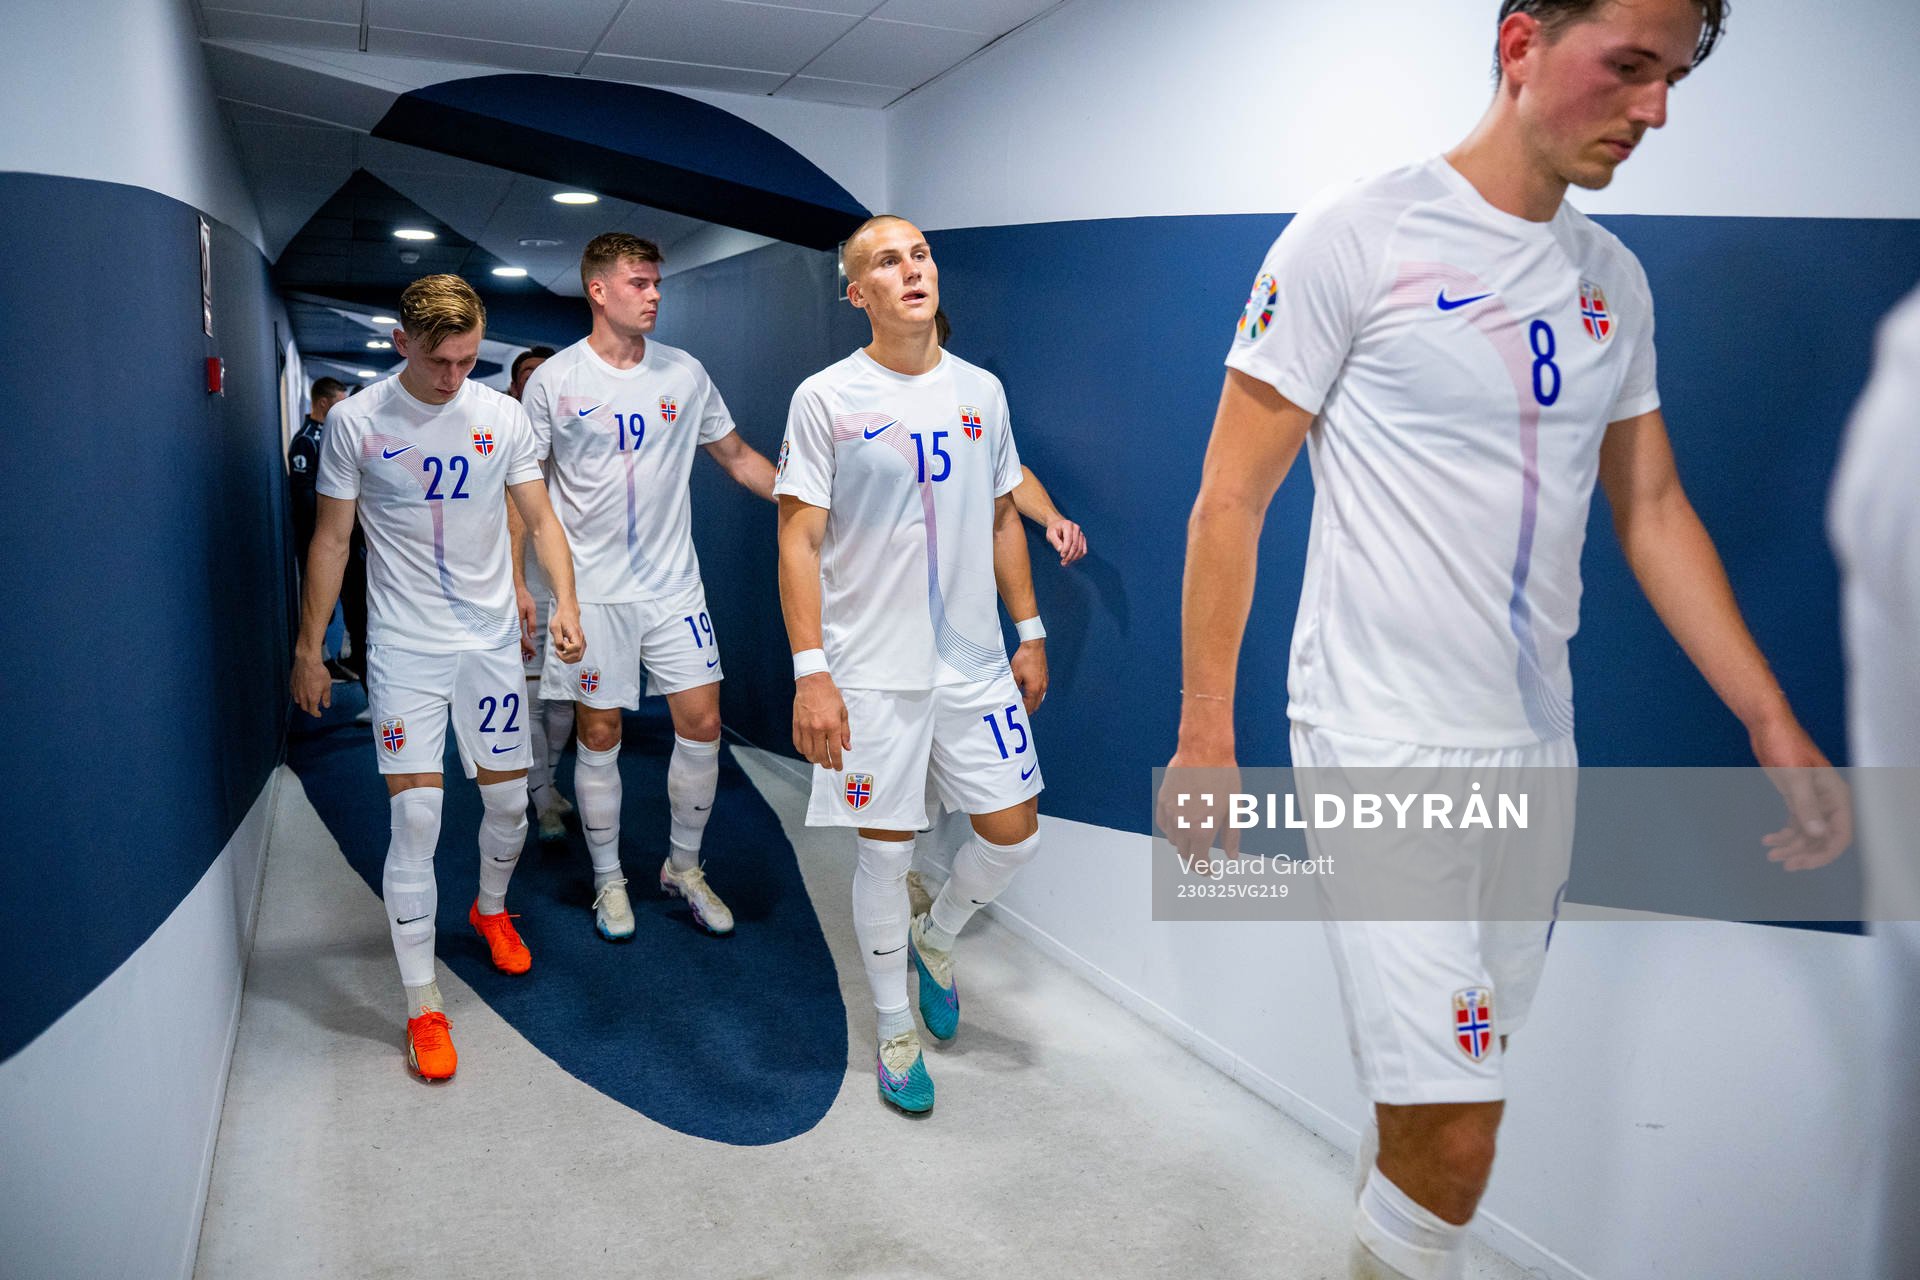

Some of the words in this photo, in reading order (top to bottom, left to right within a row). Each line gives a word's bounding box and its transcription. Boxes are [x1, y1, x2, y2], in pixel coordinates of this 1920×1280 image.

[1530, 320, 1561, 406] 8
[614, 413, 645, 451] 19
[423, 456, 469, 500] 22
[910, 431, 951, 483] 15
[684, 612, 713, 648] 19
[479, 693, 520, 733] 22
[983, 704, 1028, 760] 15
